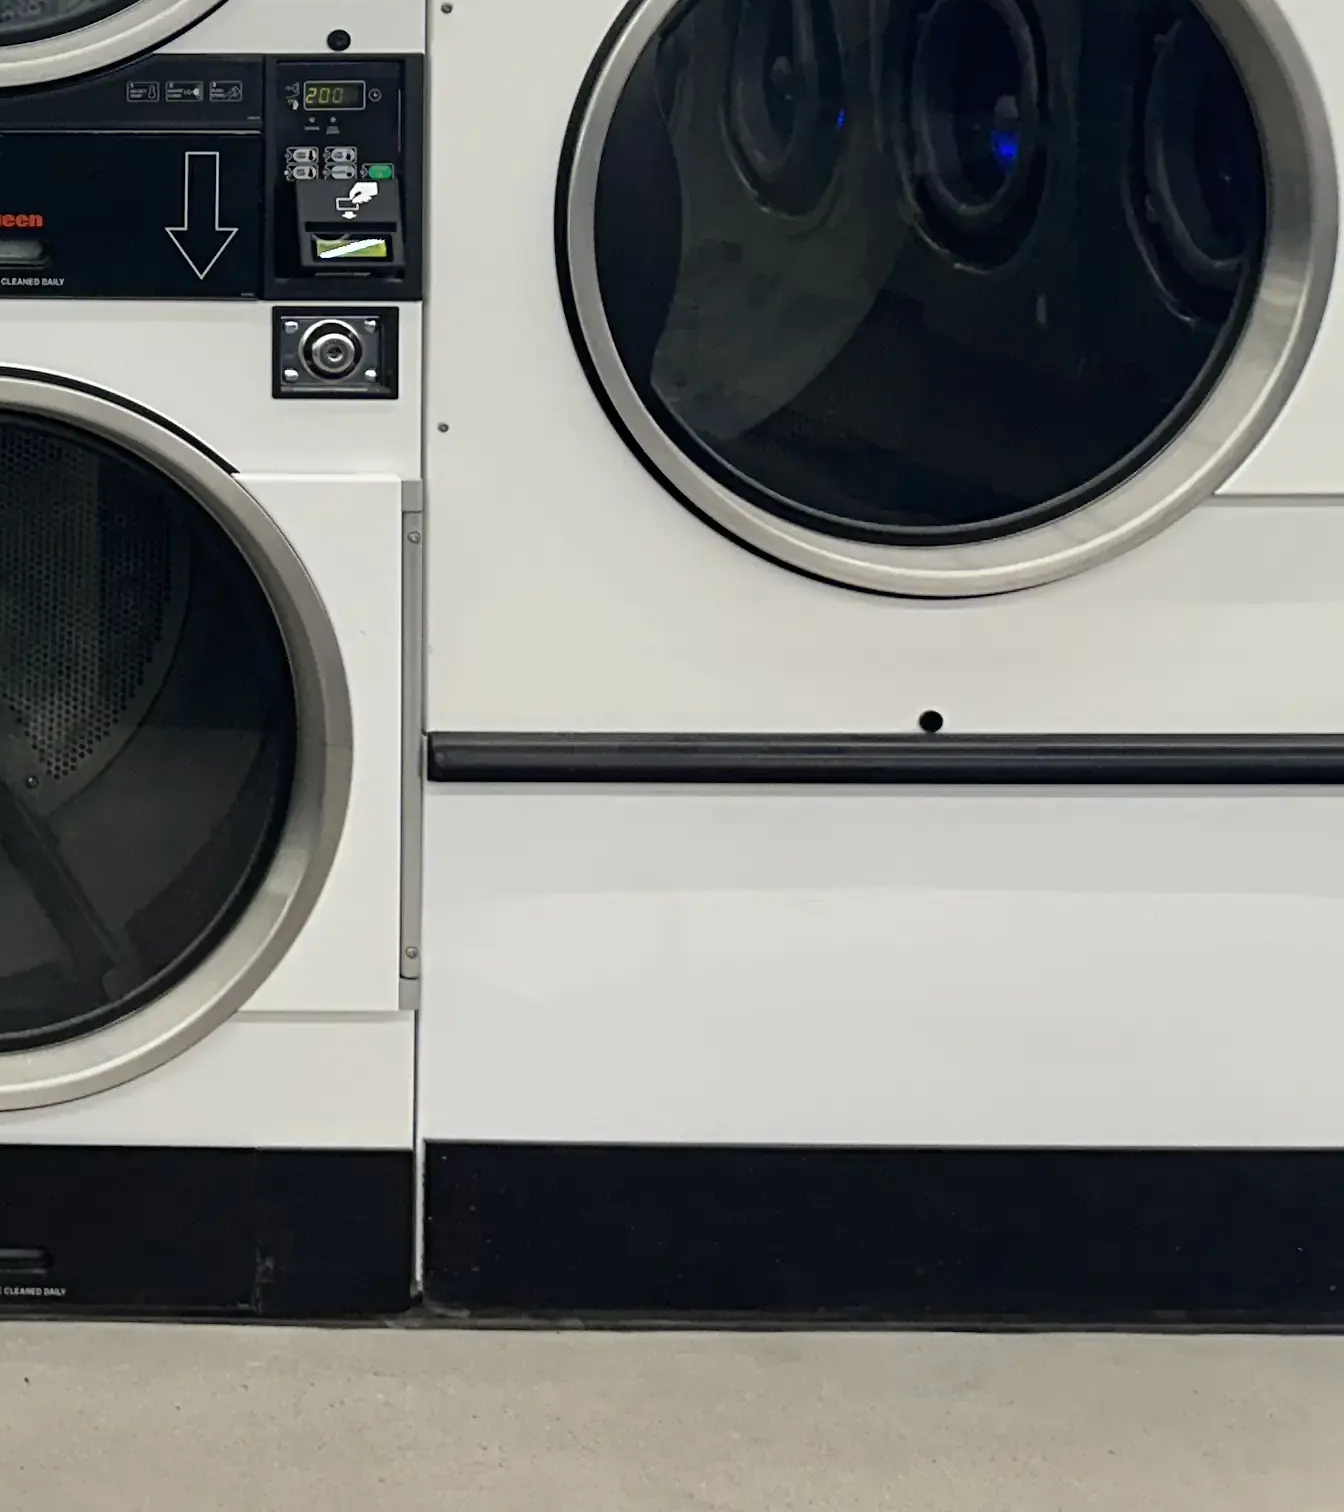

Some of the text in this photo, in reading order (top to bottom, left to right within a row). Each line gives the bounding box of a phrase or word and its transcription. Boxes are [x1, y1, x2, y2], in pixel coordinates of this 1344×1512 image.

[305, 87, 345, 104] 200
[0, 278, 40, 286] CLEANED
[41, 278, 65, 287] DAILY
